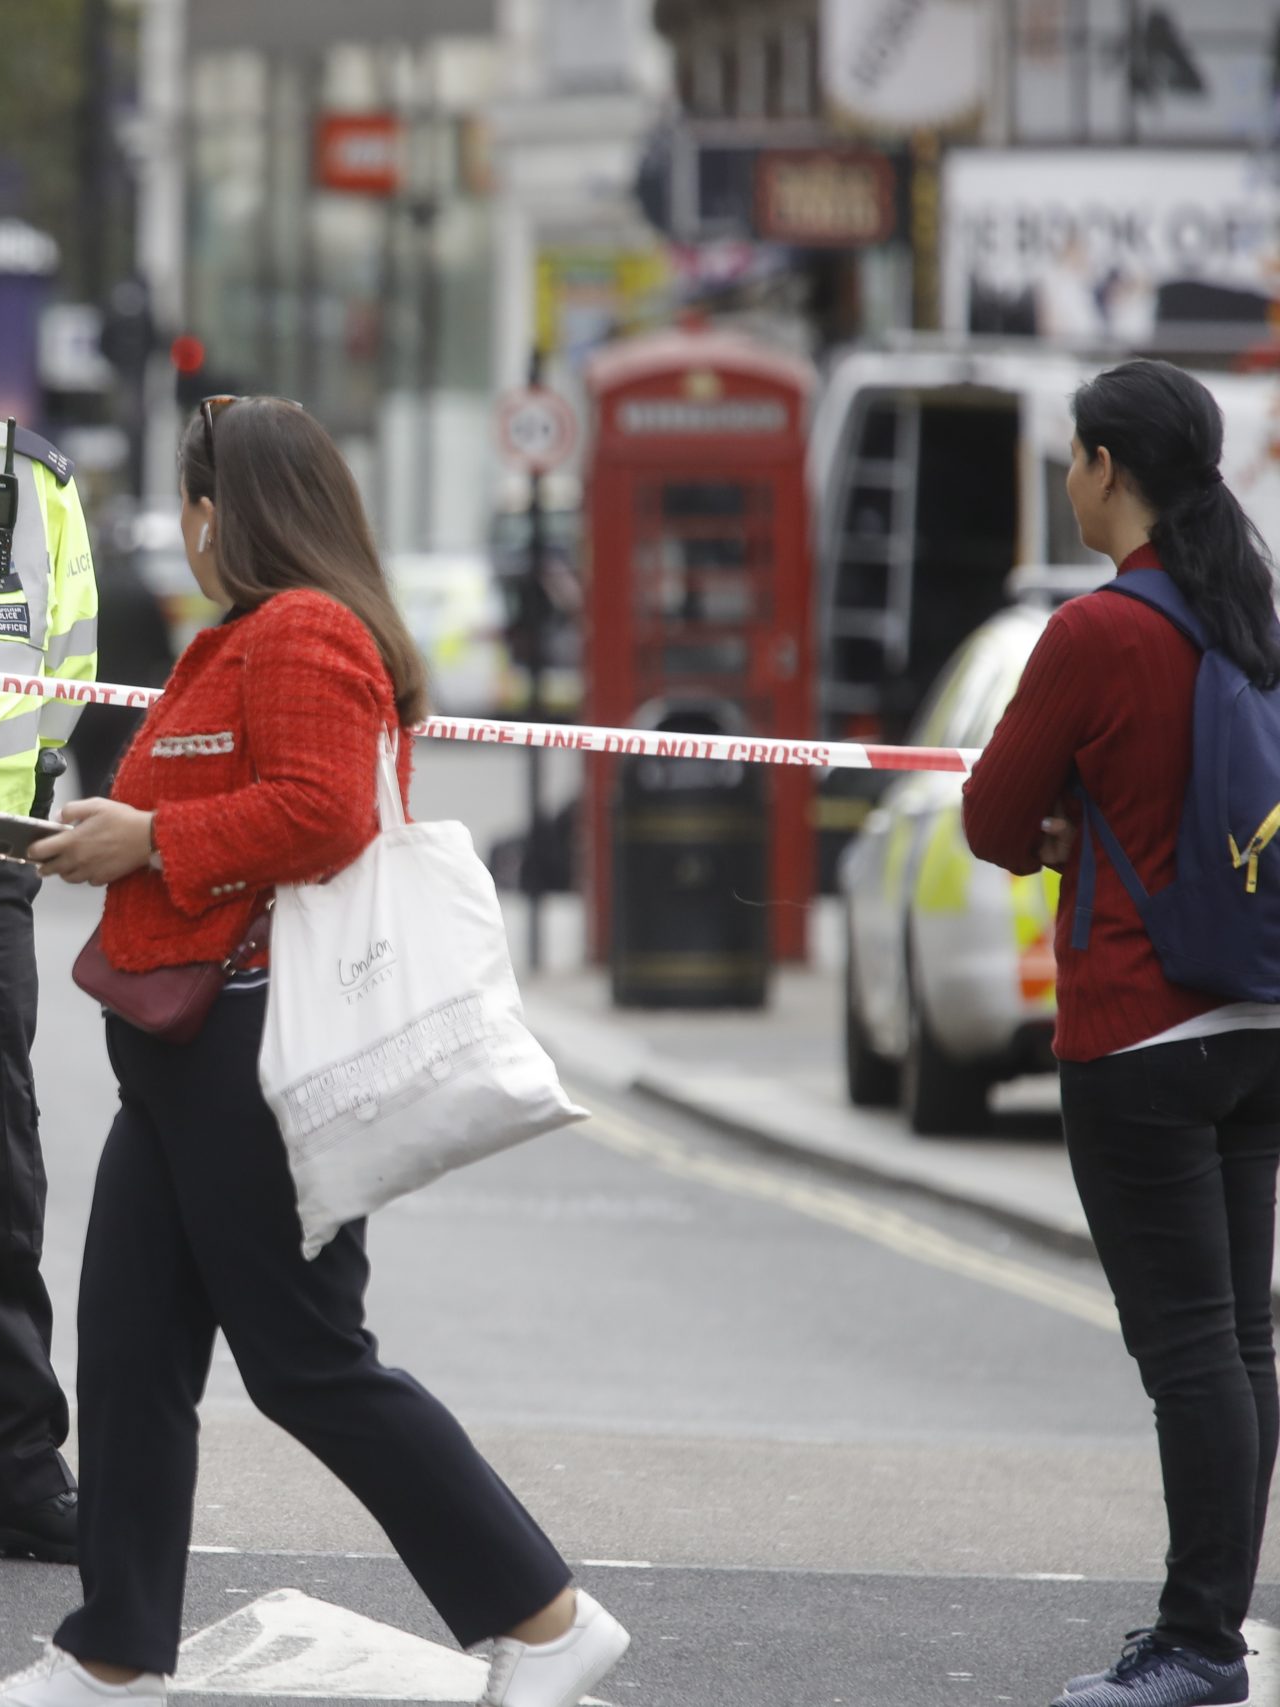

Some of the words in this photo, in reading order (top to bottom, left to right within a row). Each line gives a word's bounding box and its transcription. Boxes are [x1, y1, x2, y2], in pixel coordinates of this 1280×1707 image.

[2, 677, 45, 697] DO
[54, 682, 118, 704] NOT
[525, 727, 593, 750] LINE
[603, 734, 646, 755] DO
[656, 739, 719, 760] NOT
[726, 744, 830, 767] CROSS
[337, 938, 395, 988] London
